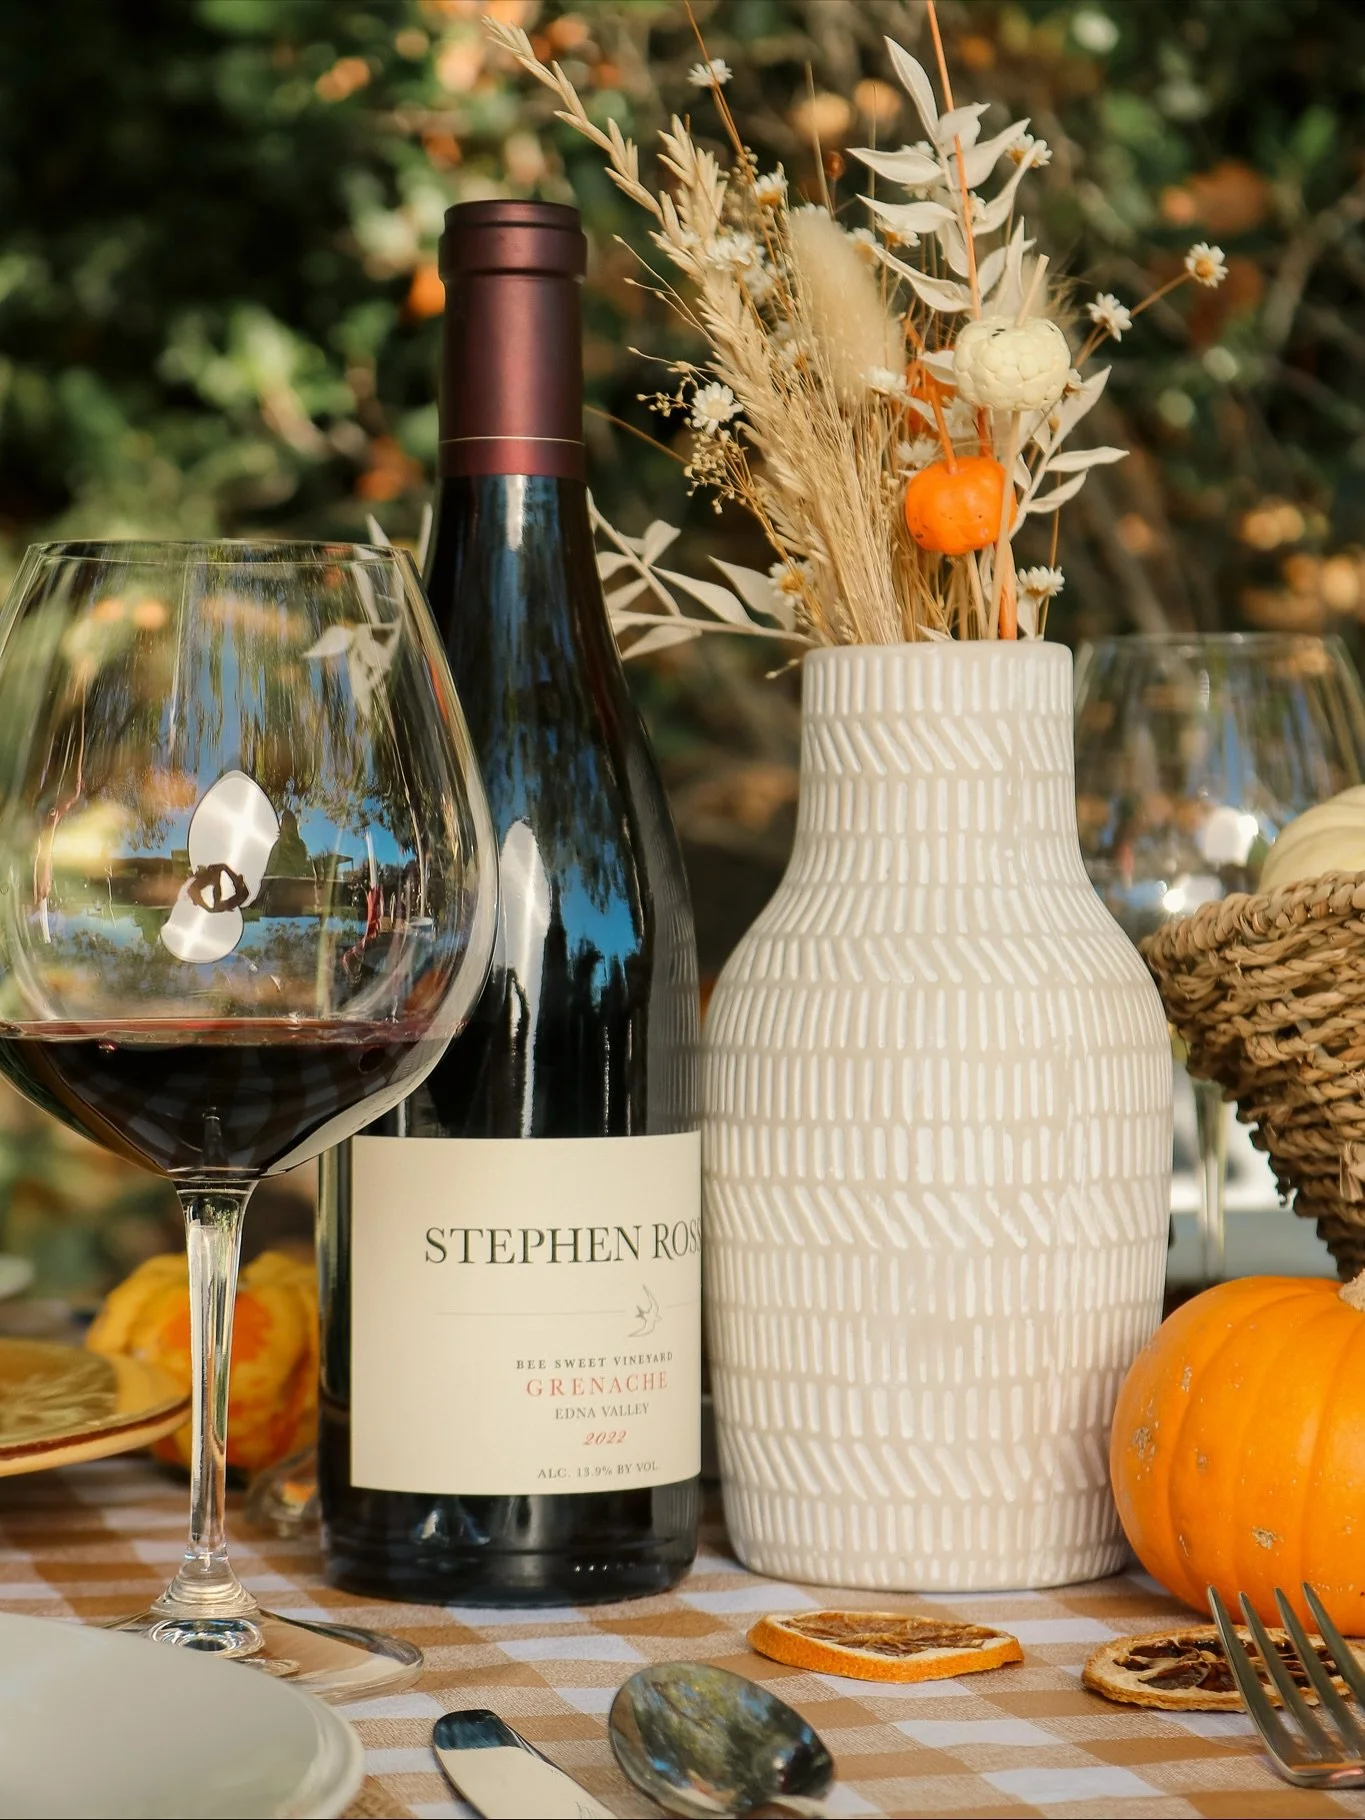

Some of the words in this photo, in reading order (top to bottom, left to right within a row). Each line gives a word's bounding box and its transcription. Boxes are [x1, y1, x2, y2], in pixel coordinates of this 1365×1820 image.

[425, 1225, 643, 1264] STEPHEN
[516, 1360, 546, 1369] BEE
[555, 1357, 607, 1369] SWEET
[613, 1351, 673, 1366] VINEYARD
[526, 1371, 668, 1397] GRENACHE
[555, 1407, 597, 1420] EDNA
[601, 1402, 650, 1417] VALLEY
[583, 1430, 627, 1446] 2022
[537, 1467, 571, 1479] ALC.
[577, 1464, 613, 1477] 13.9%
[617, 1463, 632, 1475] BY
